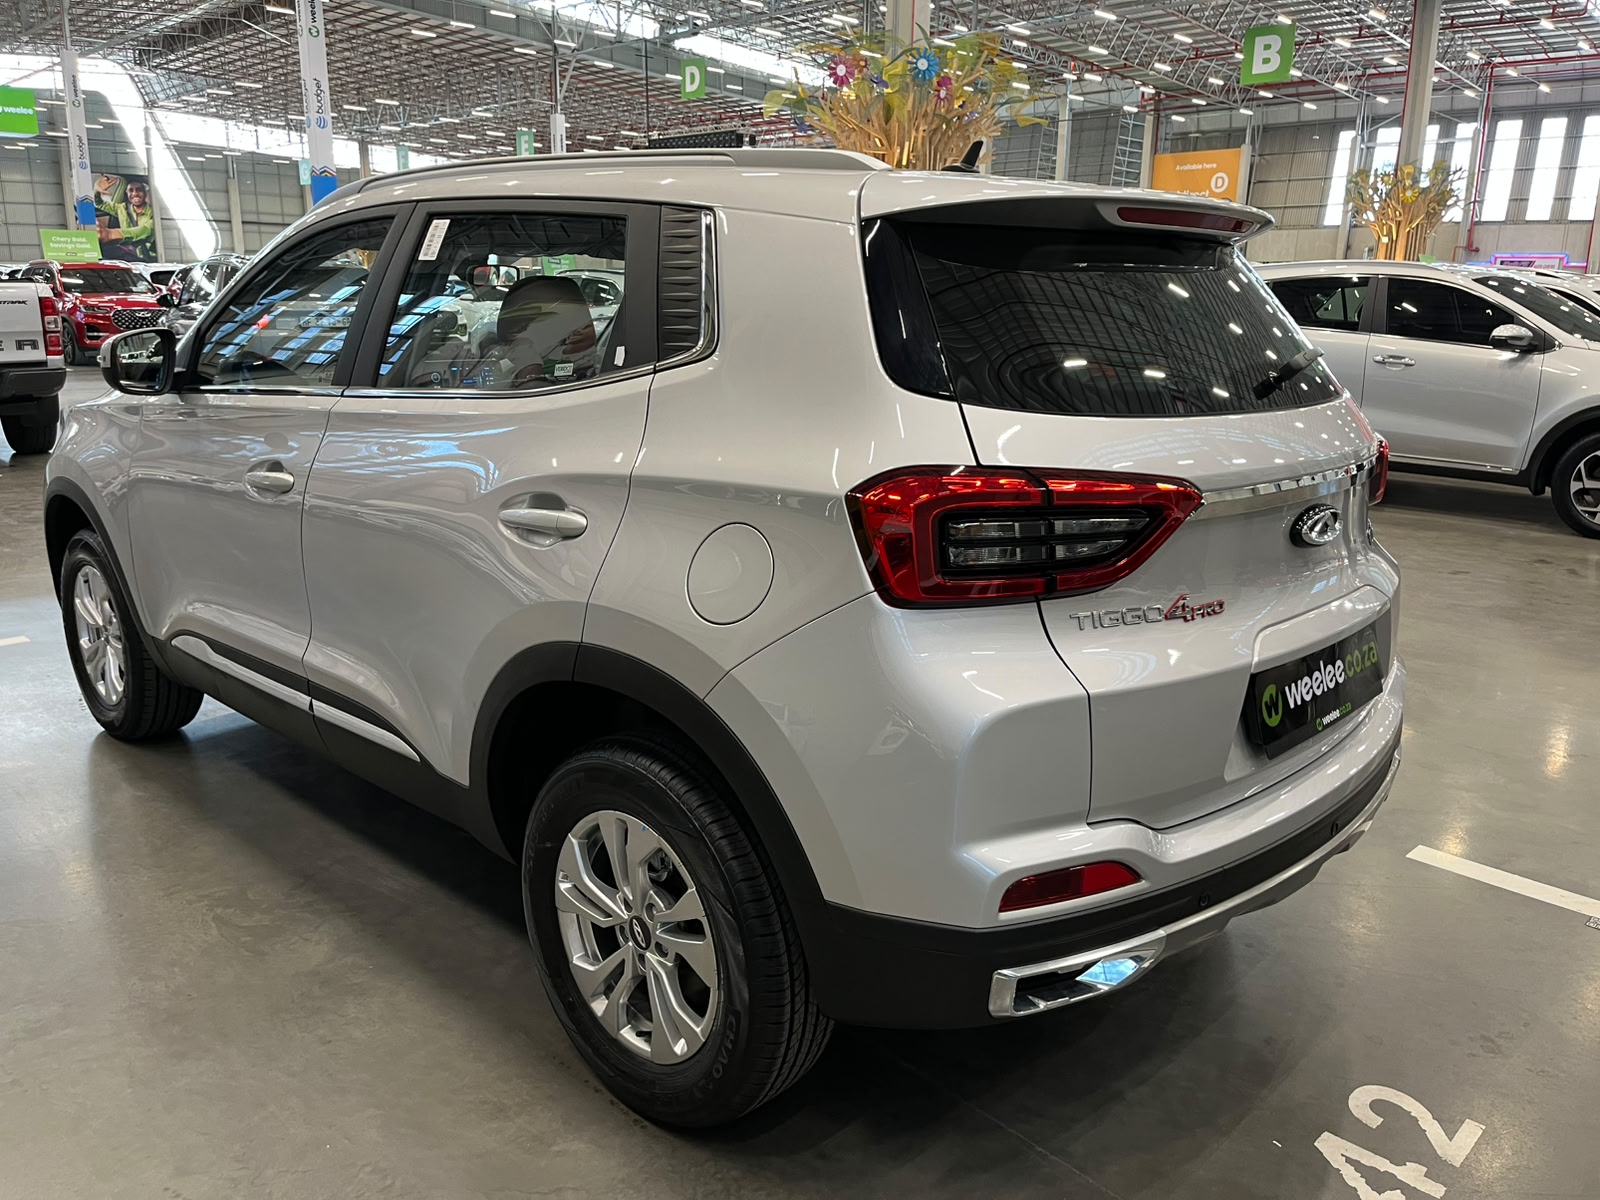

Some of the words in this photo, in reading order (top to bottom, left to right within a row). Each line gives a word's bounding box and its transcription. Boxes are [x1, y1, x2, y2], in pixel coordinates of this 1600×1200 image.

[1252, 35, 1281, 74] B
[685, 66, 700, 92] D
[3, 107, 34, 115] weelee
[313, 78, 325, 114] budget
[1175, 163, 1202, 171] Available
[1070, 604, 1165, 631] TIGGO
[1285, 641, 1378, 709] weelee.co.za
[1313, 1084, 1486, 1200] 42
